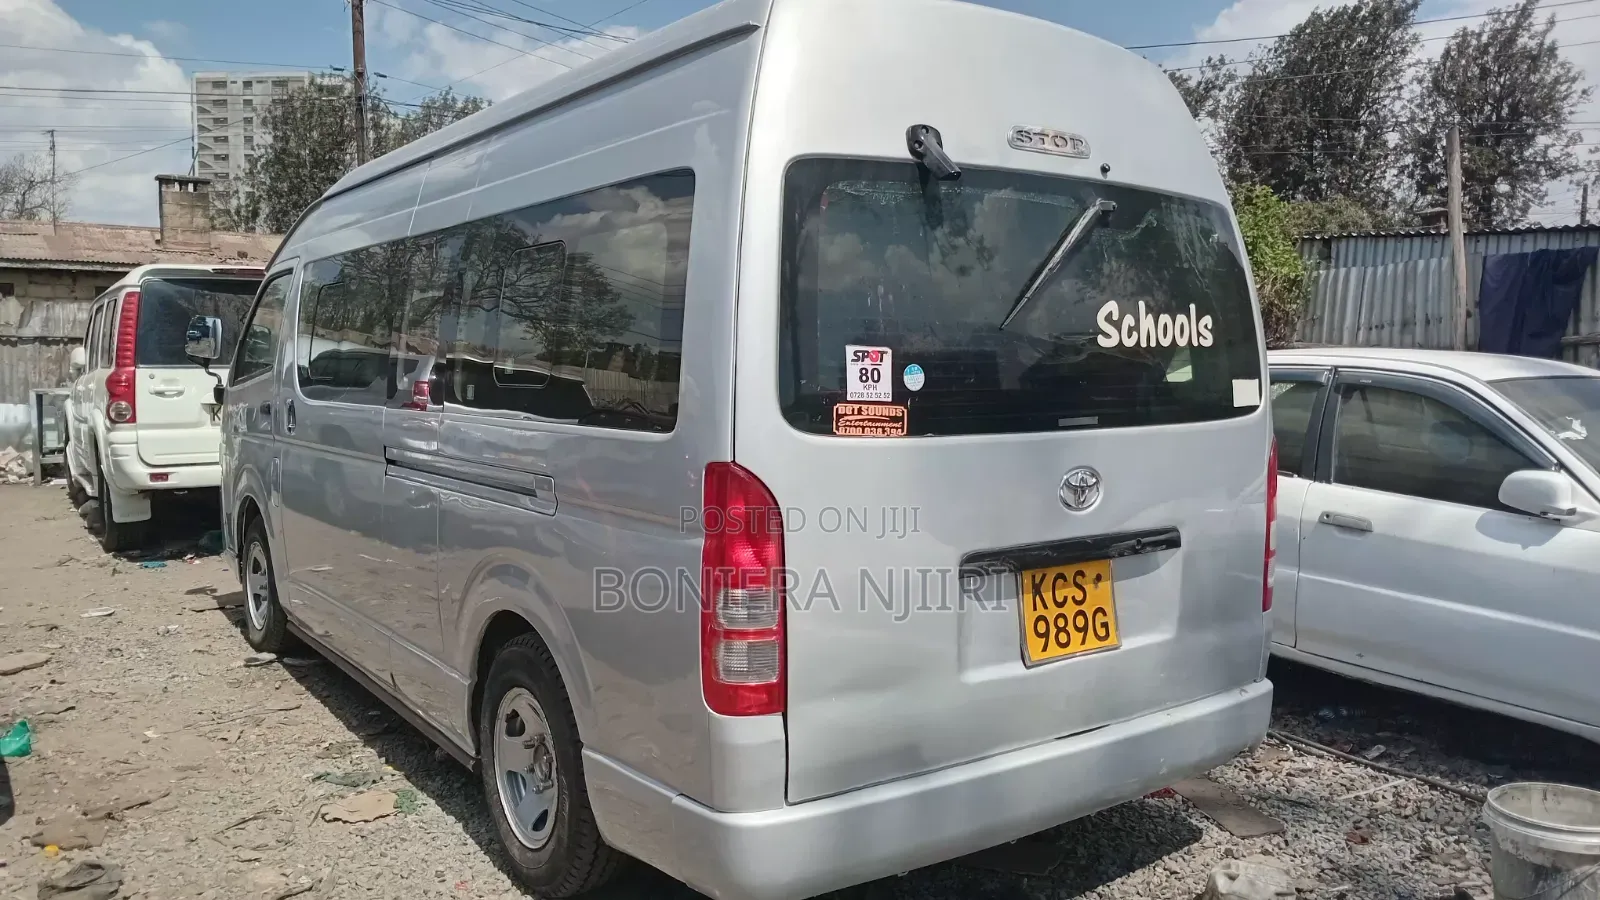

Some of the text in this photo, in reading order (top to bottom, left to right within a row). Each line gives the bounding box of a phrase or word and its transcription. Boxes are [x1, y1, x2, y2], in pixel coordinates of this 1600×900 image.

[1015, 129, 1084, 151] STOP
[1096, 300, 1214, 348] Schools
[850, 350, 888, 363] SPOT
[858, 367, 881, 383] 80
[849, 391, 865, 399] 0728
[861, 405, 903, 417] SOUNDS
[838, 420, 903, 428] Entertainment
[1031, 569, 1087, 612] KCS
[1033, 606, 1110, 653] 989G
